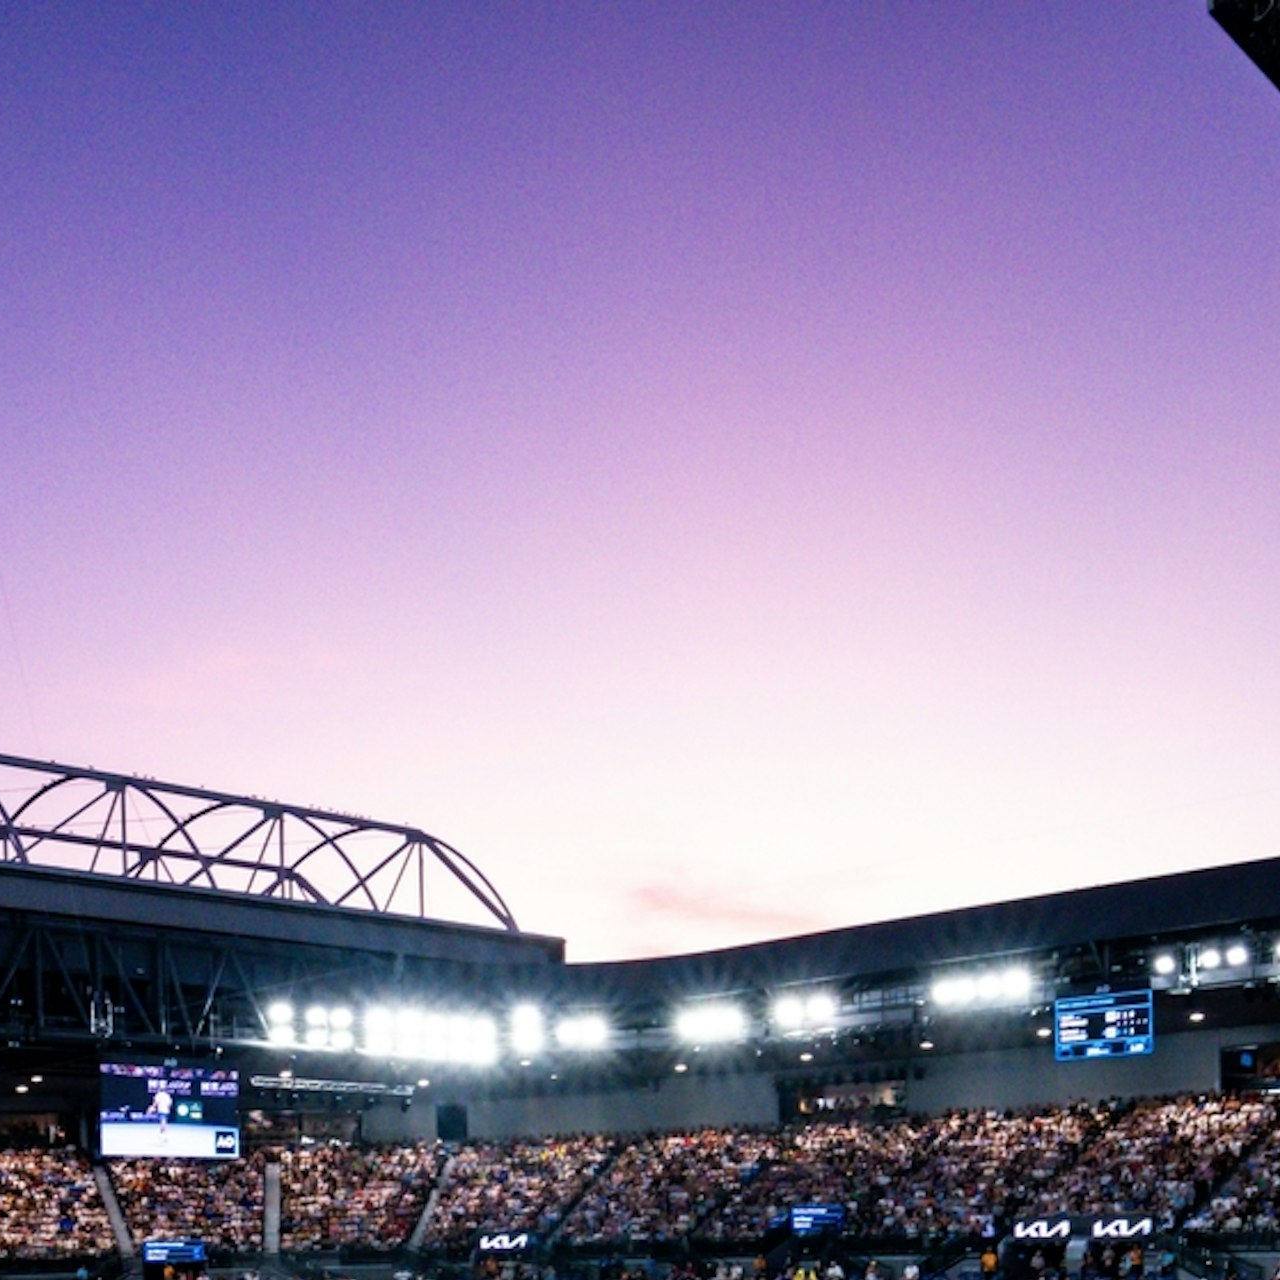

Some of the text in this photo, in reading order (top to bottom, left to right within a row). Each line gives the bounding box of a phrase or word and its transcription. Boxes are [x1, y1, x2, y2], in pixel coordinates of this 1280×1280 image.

[1014, 1219, 1070, 1239] KIA
[1092, 1218, 1153, 1239] KIA
[480, 1233, 528, 1250] KIA
